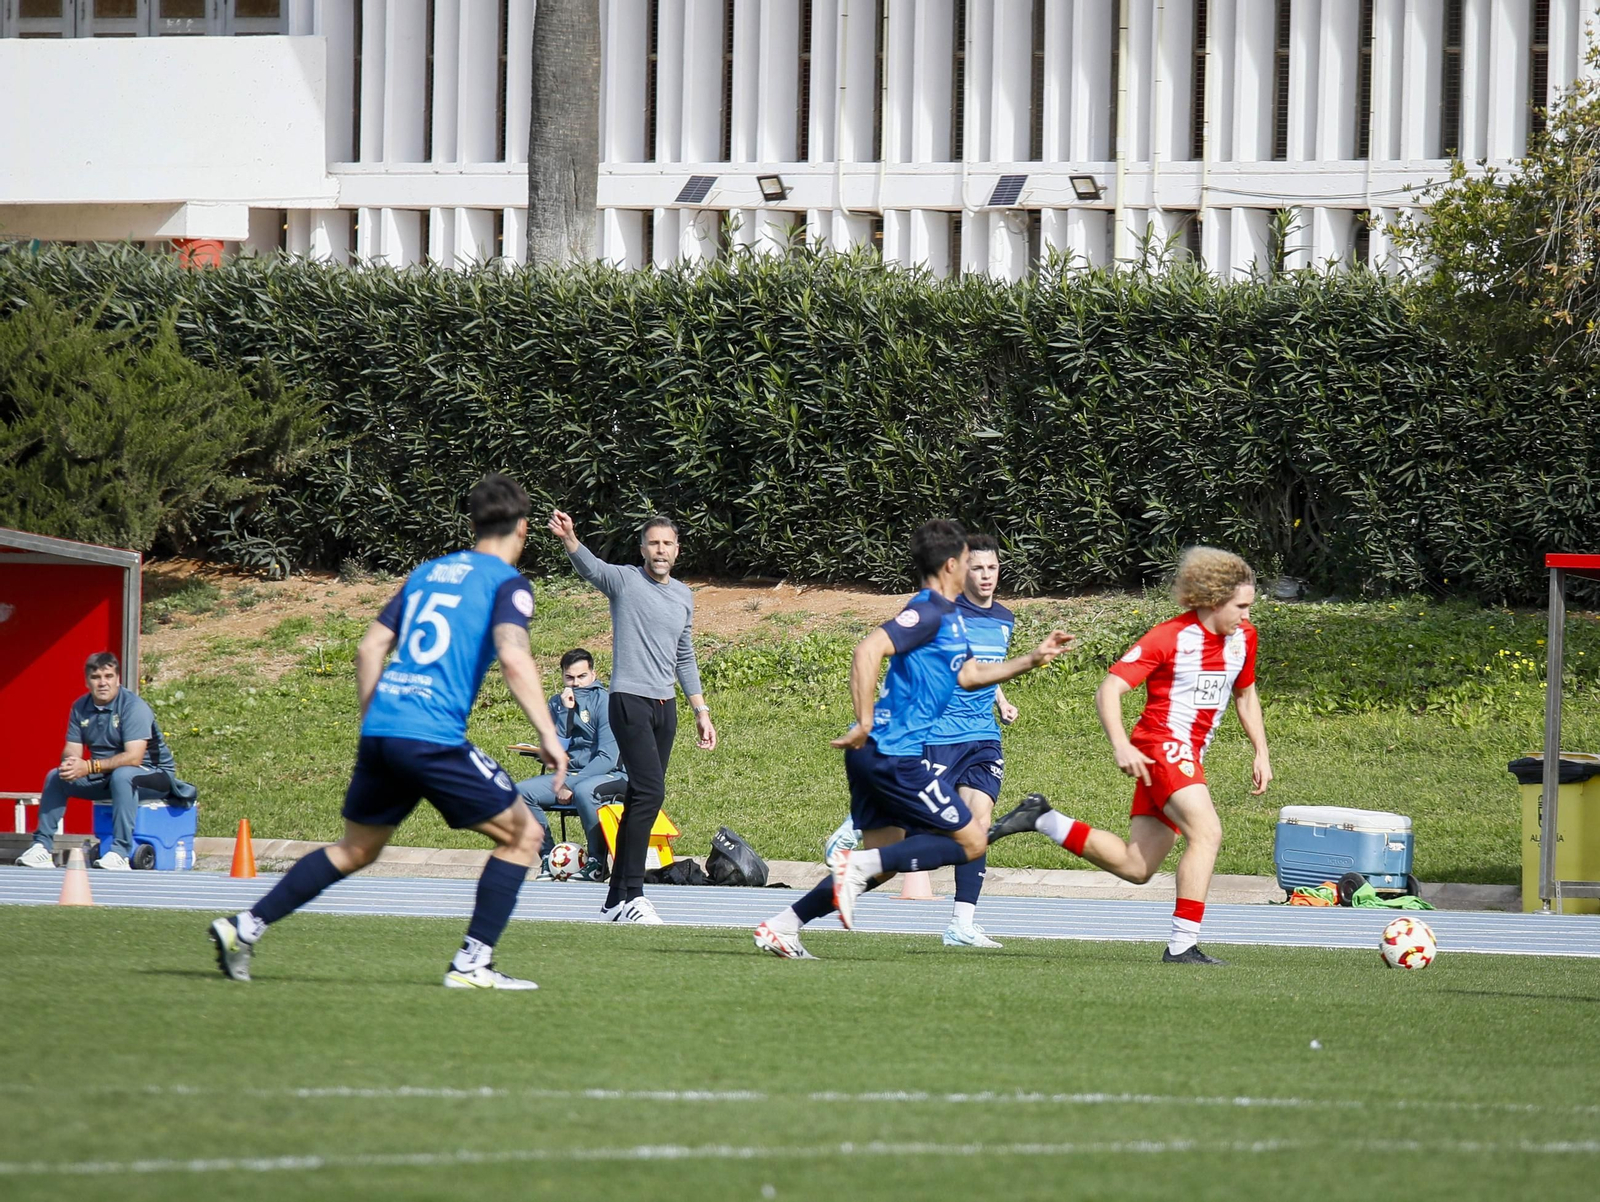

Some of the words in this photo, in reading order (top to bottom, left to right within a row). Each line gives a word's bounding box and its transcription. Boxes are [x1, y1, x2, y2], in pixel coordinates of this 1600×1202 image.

[391, 588, 463, 665] 15
[1201, 690, 1216, 701] ZN
[1203, 679, 1219, 690] DA
[917, 779, 951, 814] 17
